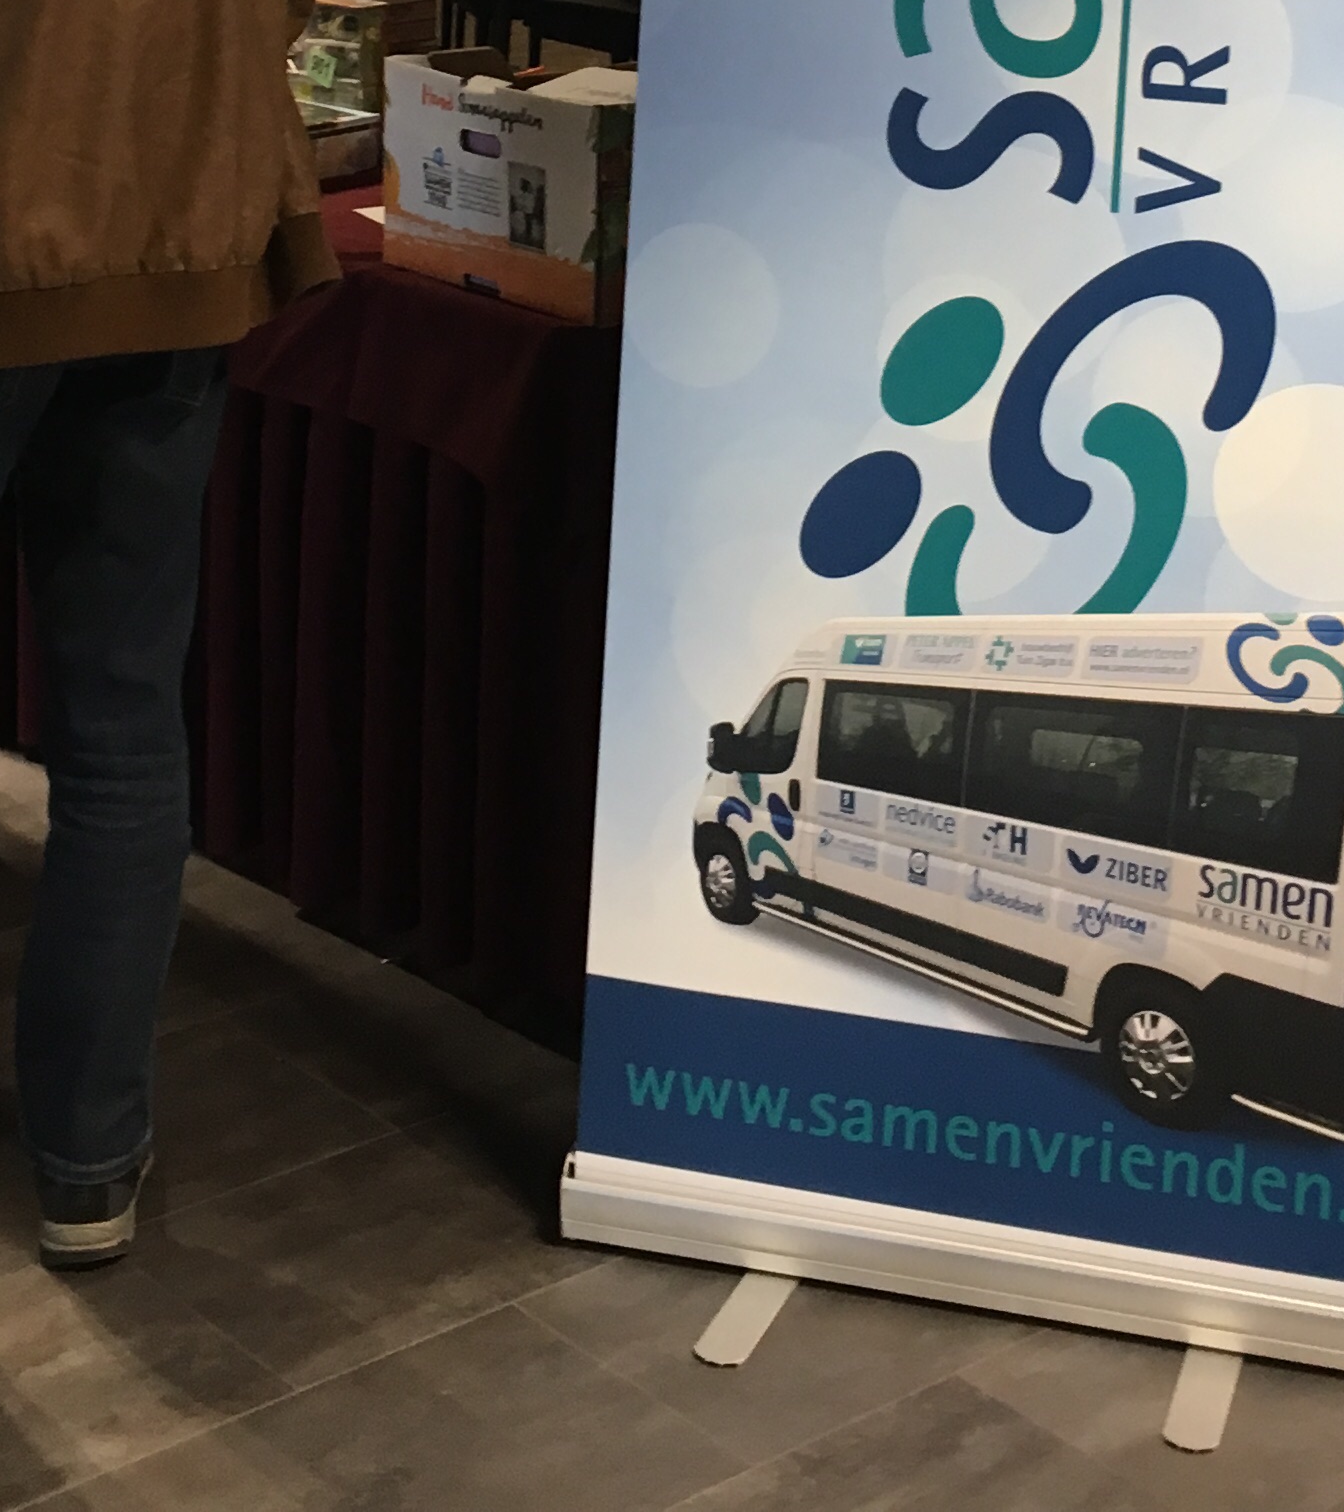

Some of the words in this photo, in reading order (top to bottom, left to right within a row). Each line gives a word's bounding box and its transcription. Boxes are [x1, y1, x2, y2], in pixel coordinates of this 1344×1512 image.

[885, 803, 956, 835] nedvice
[1105, 857, 1169, 892] ZIBER
[1197, 864, 1334, 928] samen
[1195, 902, 1332, 952] VRIENDEN
